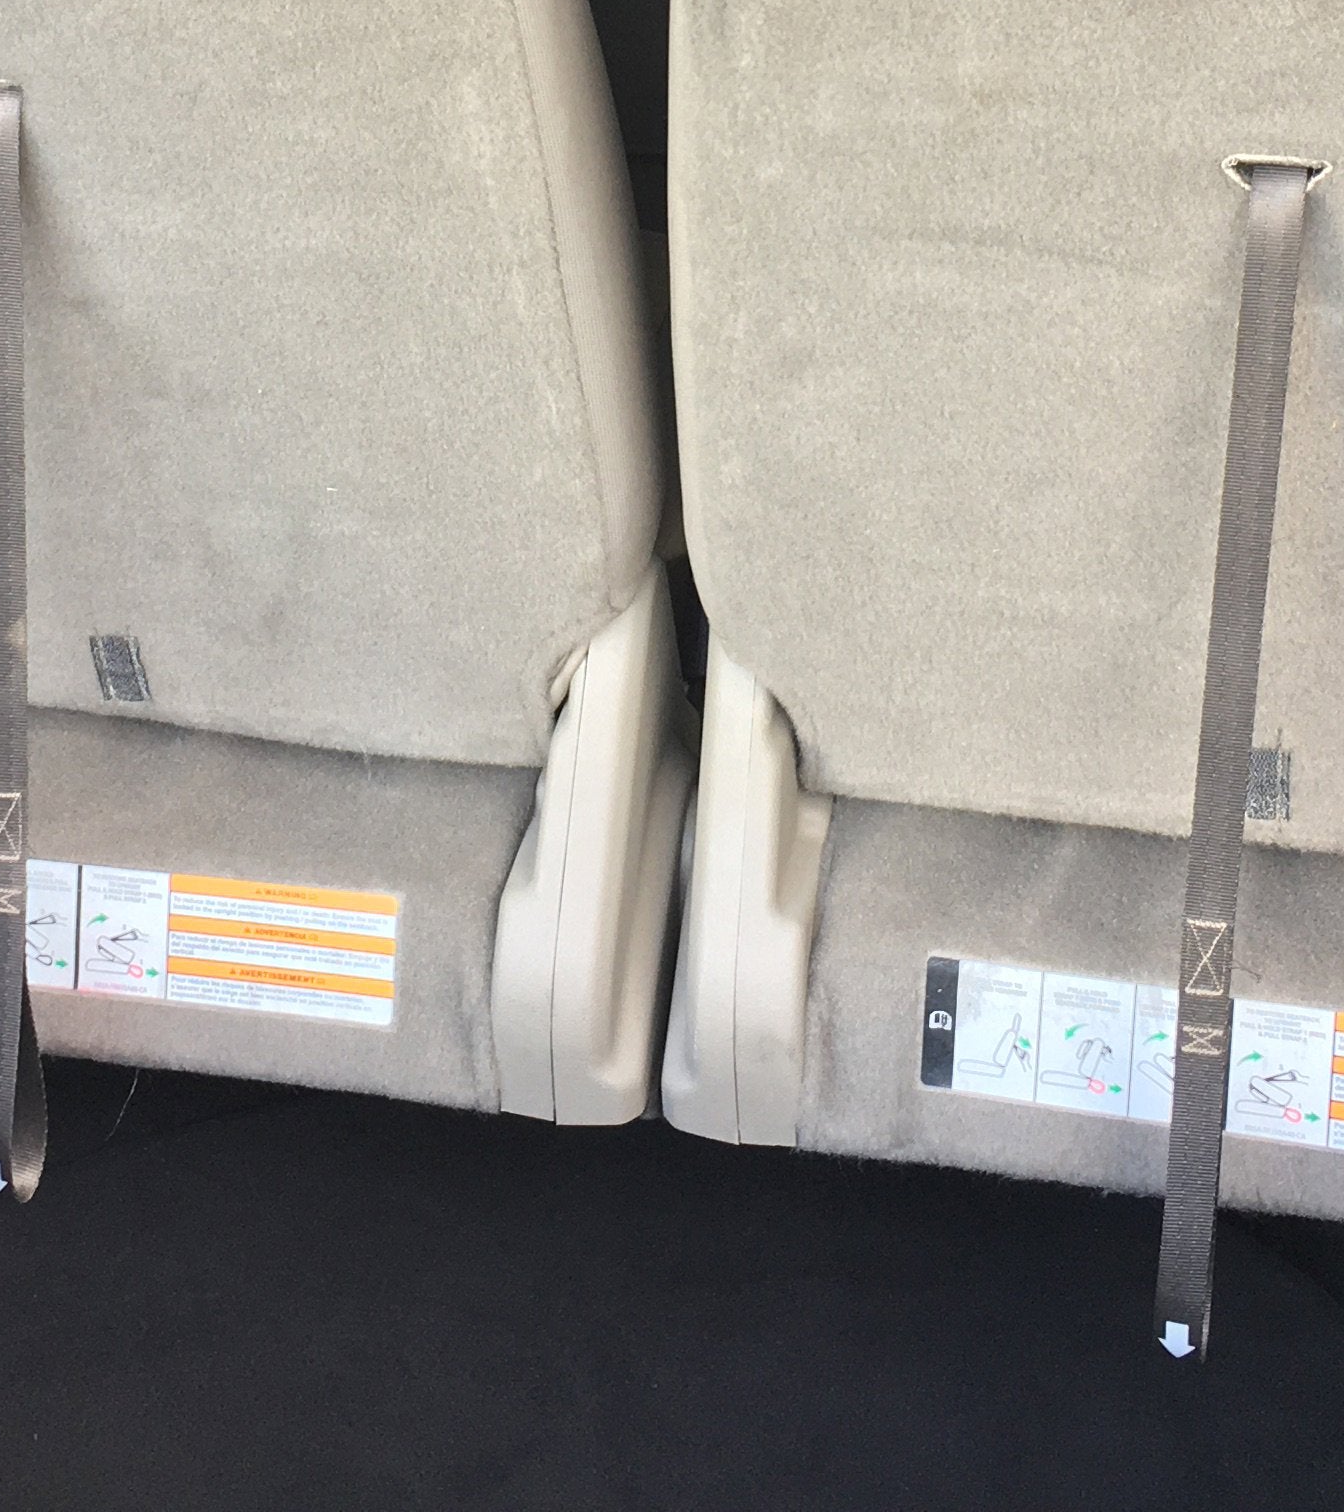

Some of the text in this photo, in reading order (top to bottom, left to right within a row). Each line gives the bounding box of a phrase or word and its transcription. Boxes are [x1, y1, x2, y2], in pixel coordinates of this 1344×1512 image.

[264, 888, 306, 899] WARNING
[253, 927, 306, 940] ADVERTENCIA
[239, 968, 315, 984] AVERTISSEMENT
